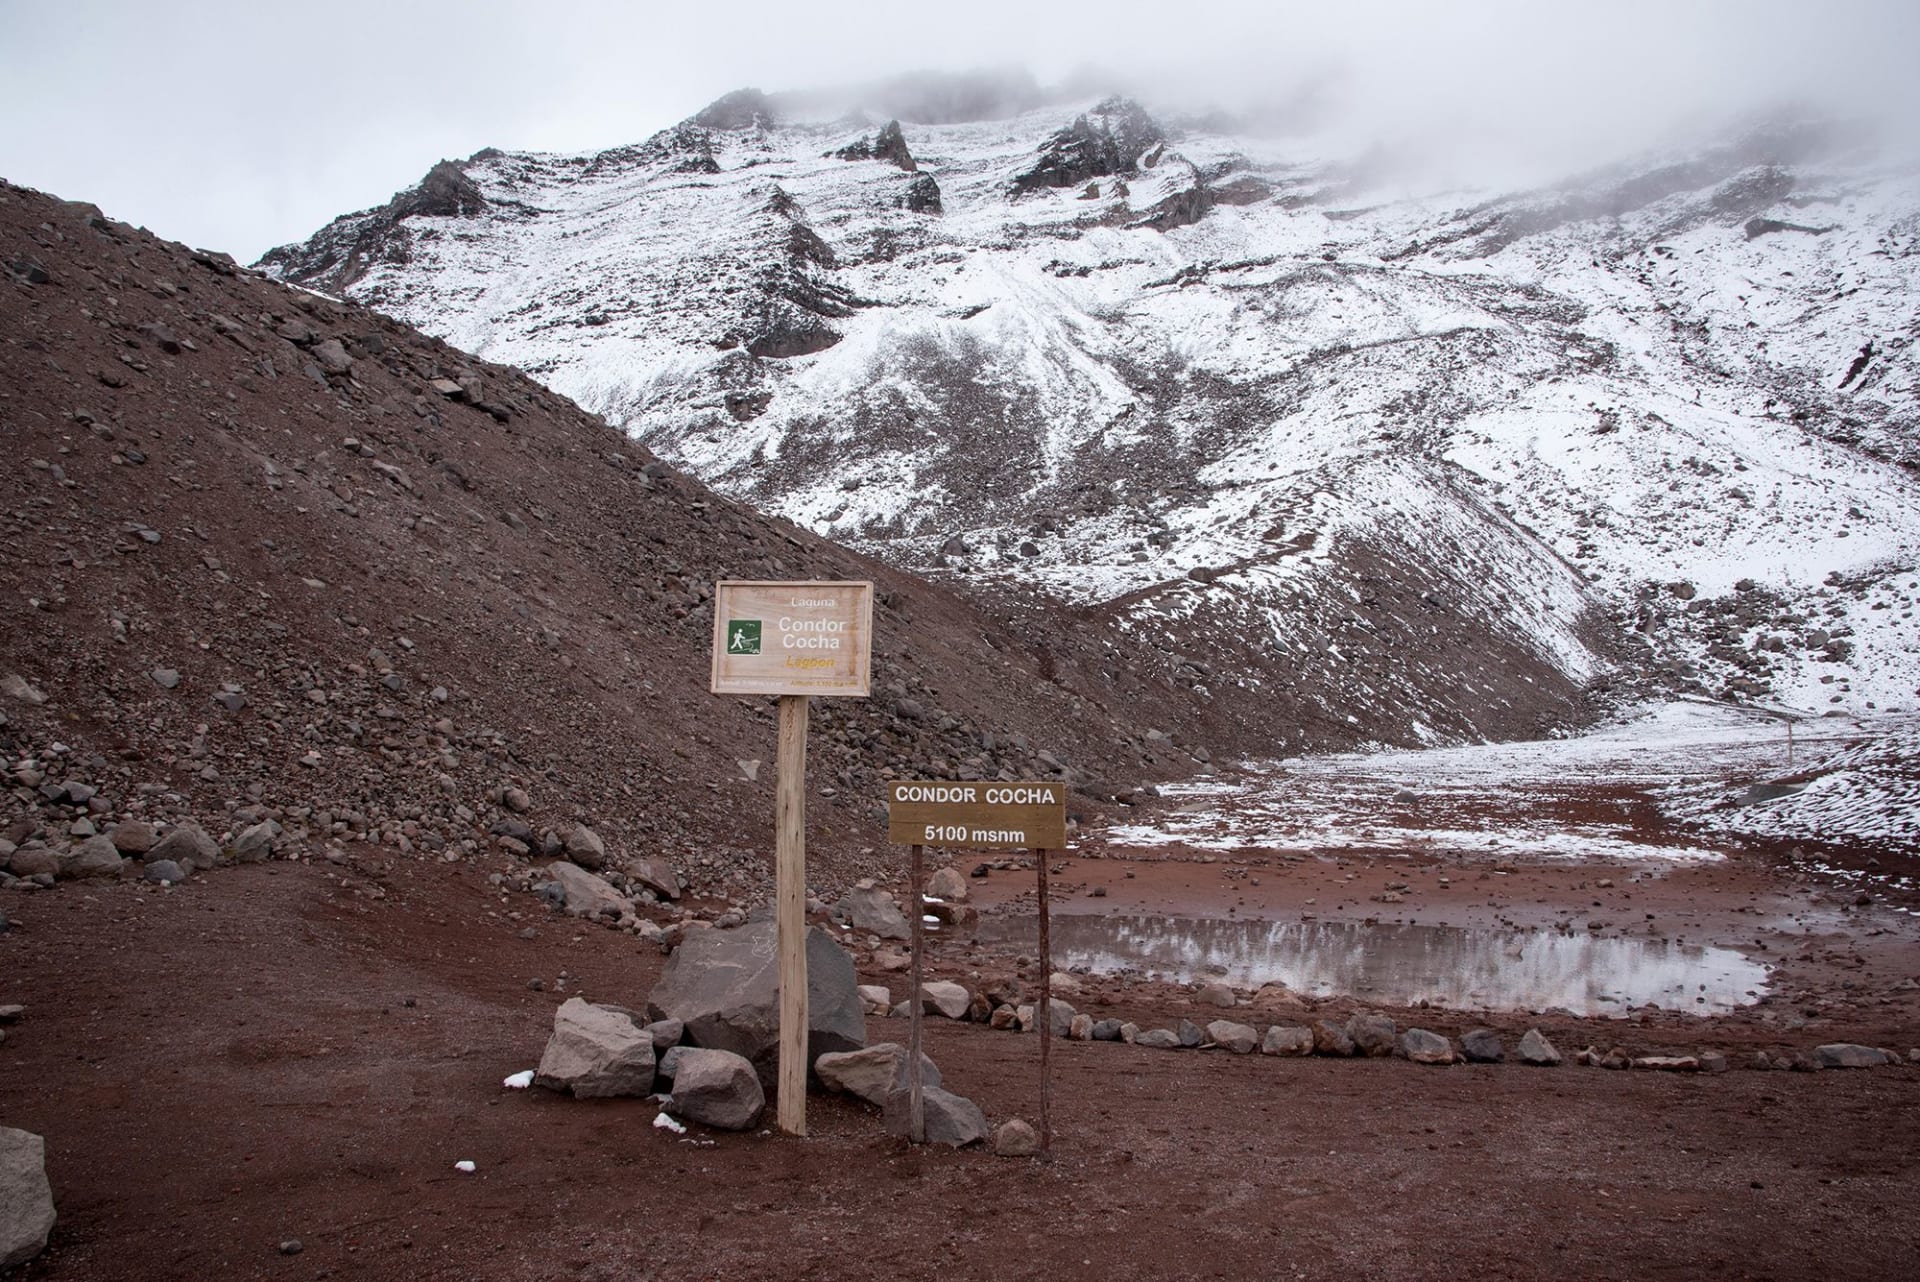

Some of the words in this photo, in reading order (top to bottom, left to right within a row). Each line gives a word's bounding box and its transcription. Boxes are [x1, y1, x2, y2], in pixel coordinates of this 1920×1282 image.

[791, 597, 836, 608] Laguna
[778, 617, 848, 632] Condor
[783, 634, 840, 649] Cocha
[786, 655, 835, 670] Lagoon
[895, 786, 977, 803] CONDOR
[985, 788, 1056, 805] COCHA
[924, 826, 967, 841] 5100
[972, 829, 1026, 843] msnm
